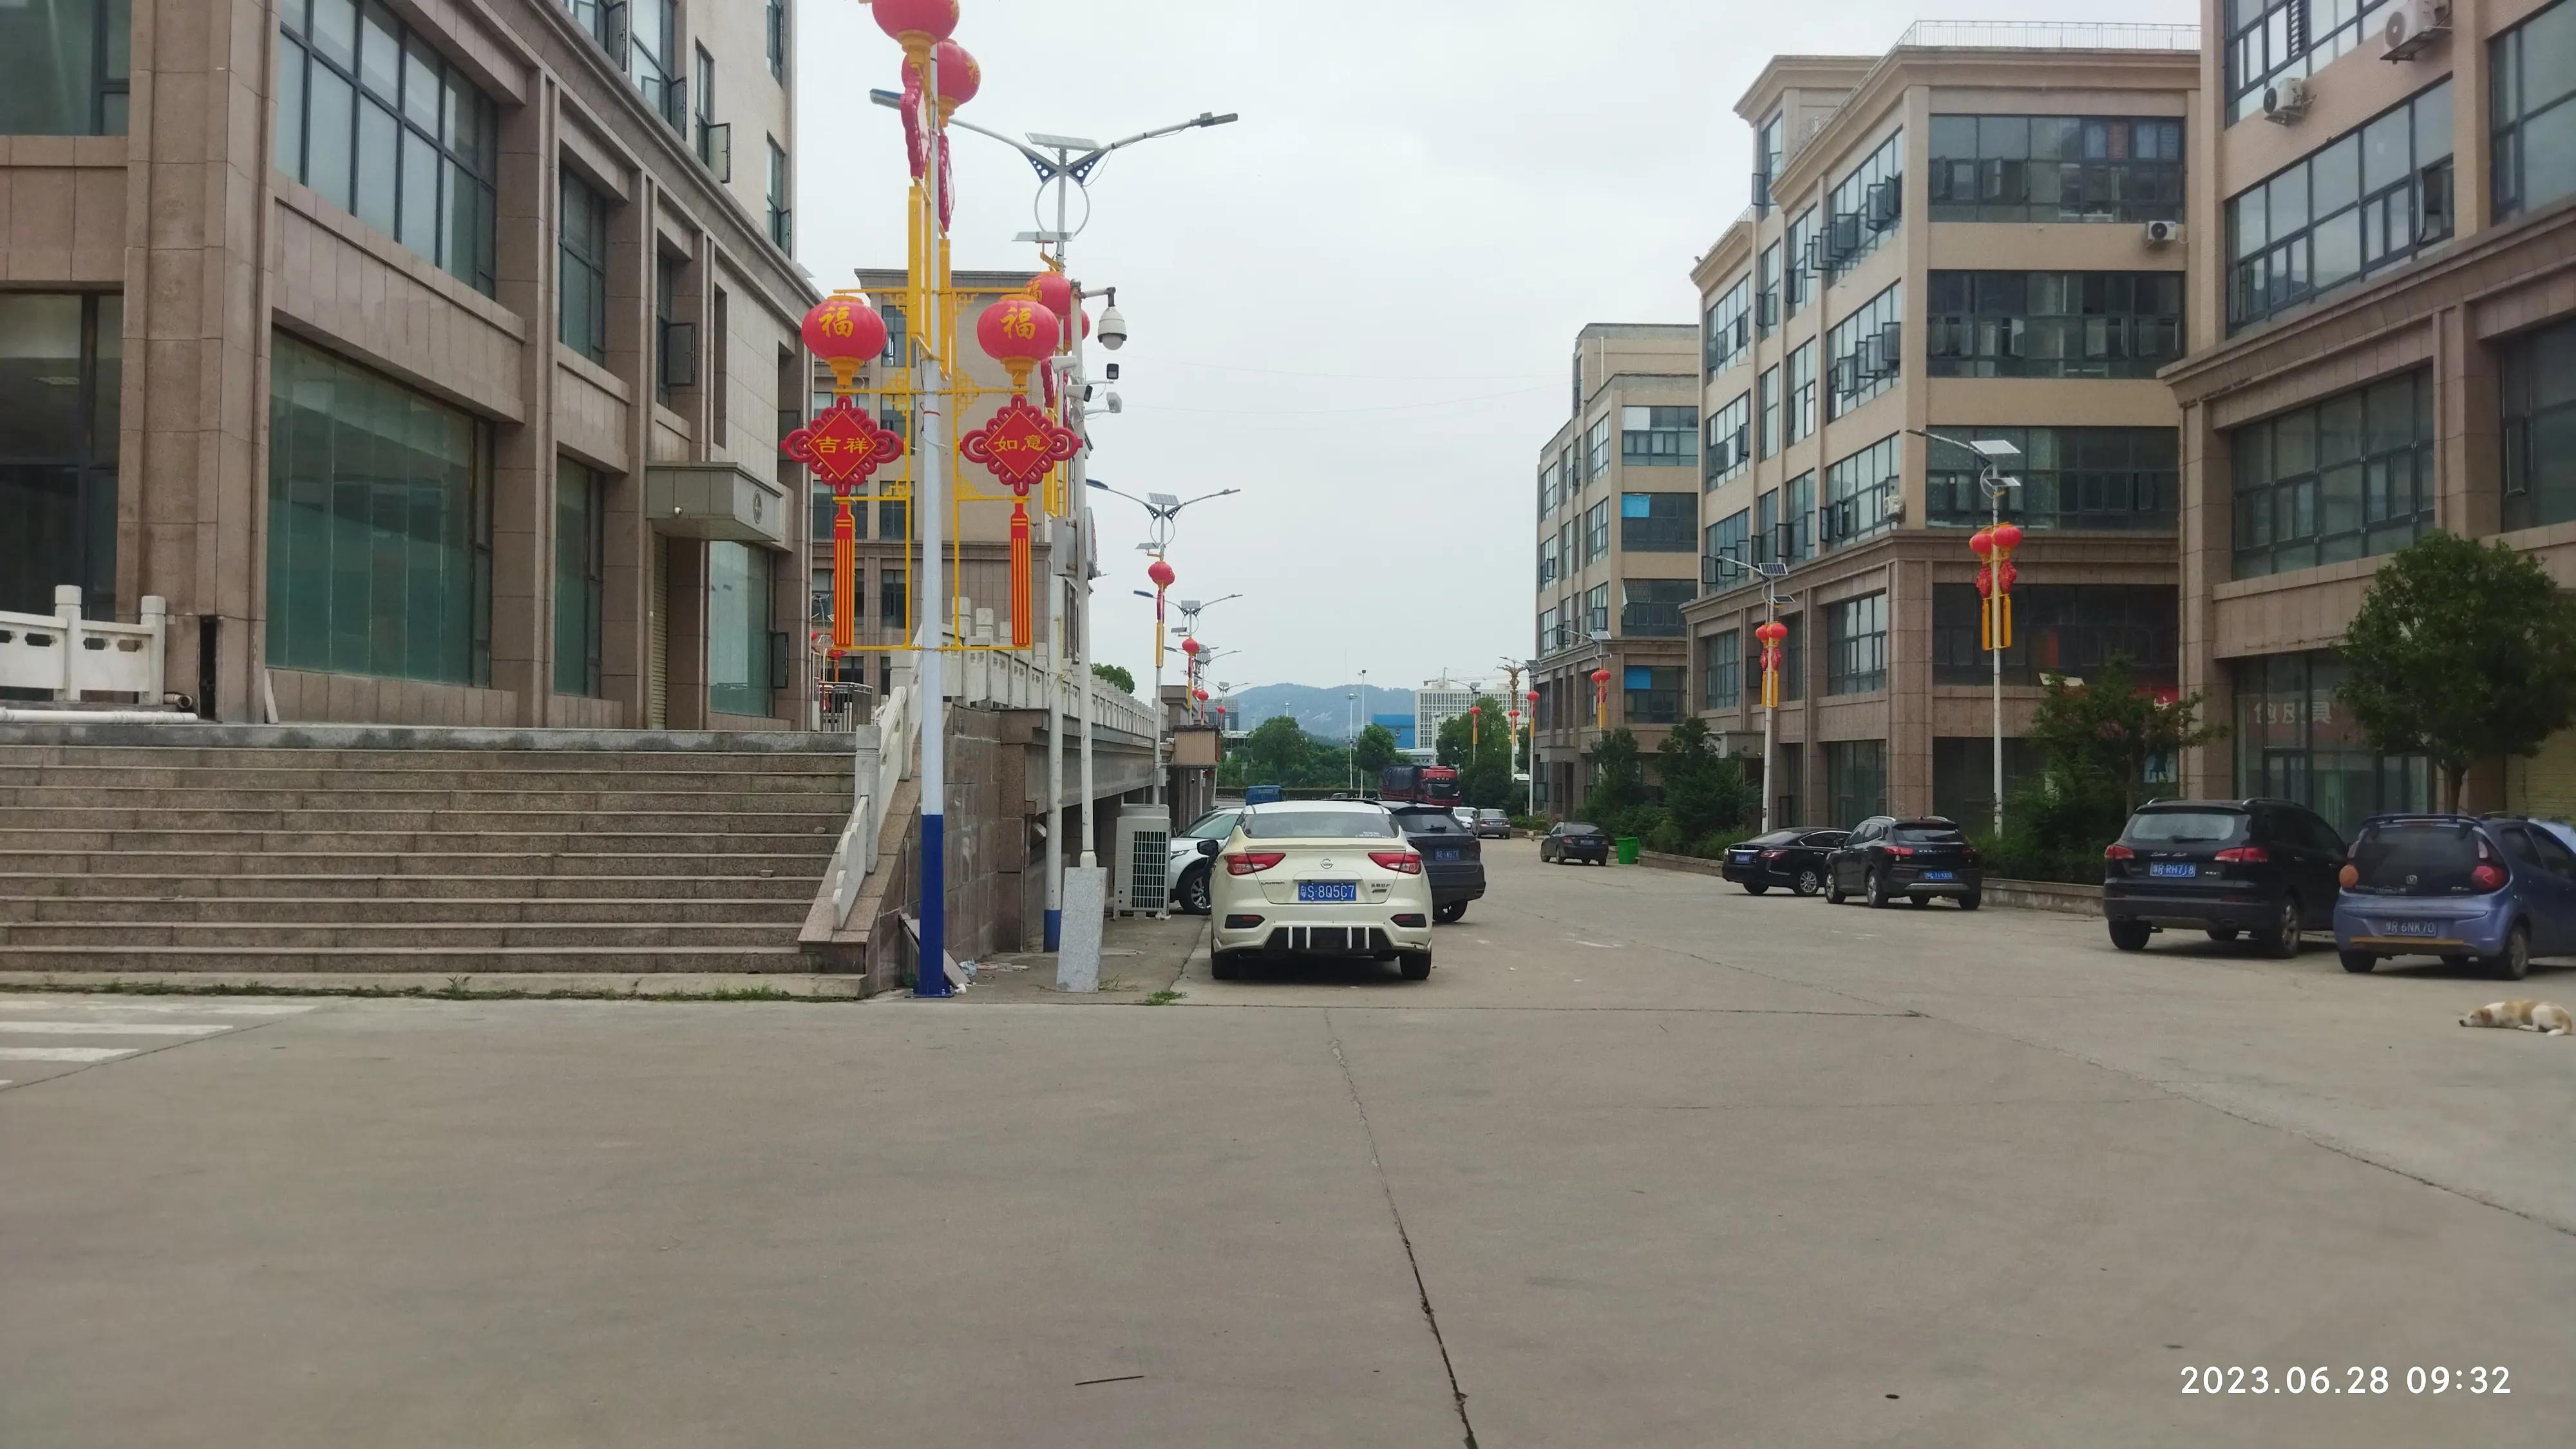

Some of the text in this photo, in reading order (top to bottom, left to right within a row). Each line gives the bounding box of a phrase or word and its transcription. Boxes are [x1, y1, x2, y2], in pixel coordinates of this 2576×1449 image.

[819, 306, 854, 338] 福
[999, 306, 1036, 340] 福
[815, 436, 869, 453] 吉祥
[994, 435, 1045, 452] 如意
